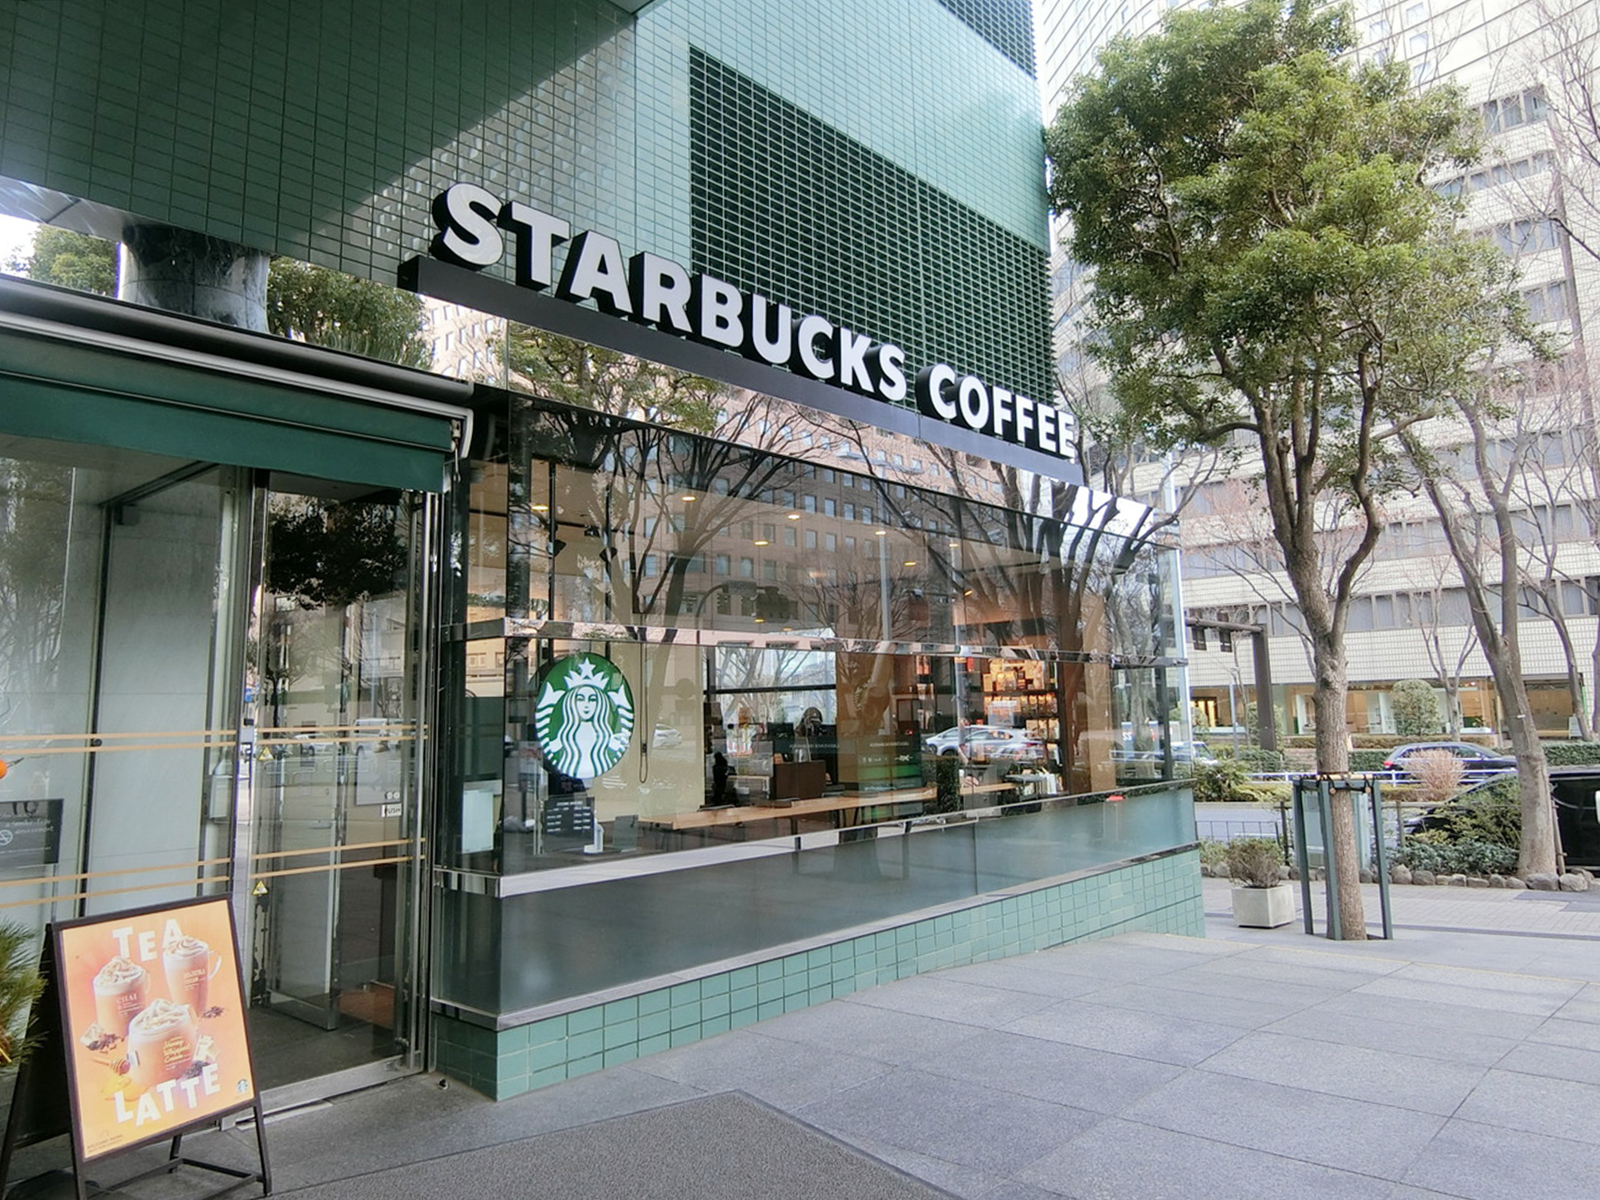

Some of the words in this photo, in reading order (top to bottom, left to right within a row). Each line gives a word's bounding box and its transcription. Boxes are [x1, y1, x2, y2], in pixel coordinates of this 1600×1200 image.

[438, 182, 908, 401] STARBUCKS
[922, 363, 1076, 459] COFFEE
[112, 918, 184, 962] TEA
[114, 1063, 221, 1128] LATTE
